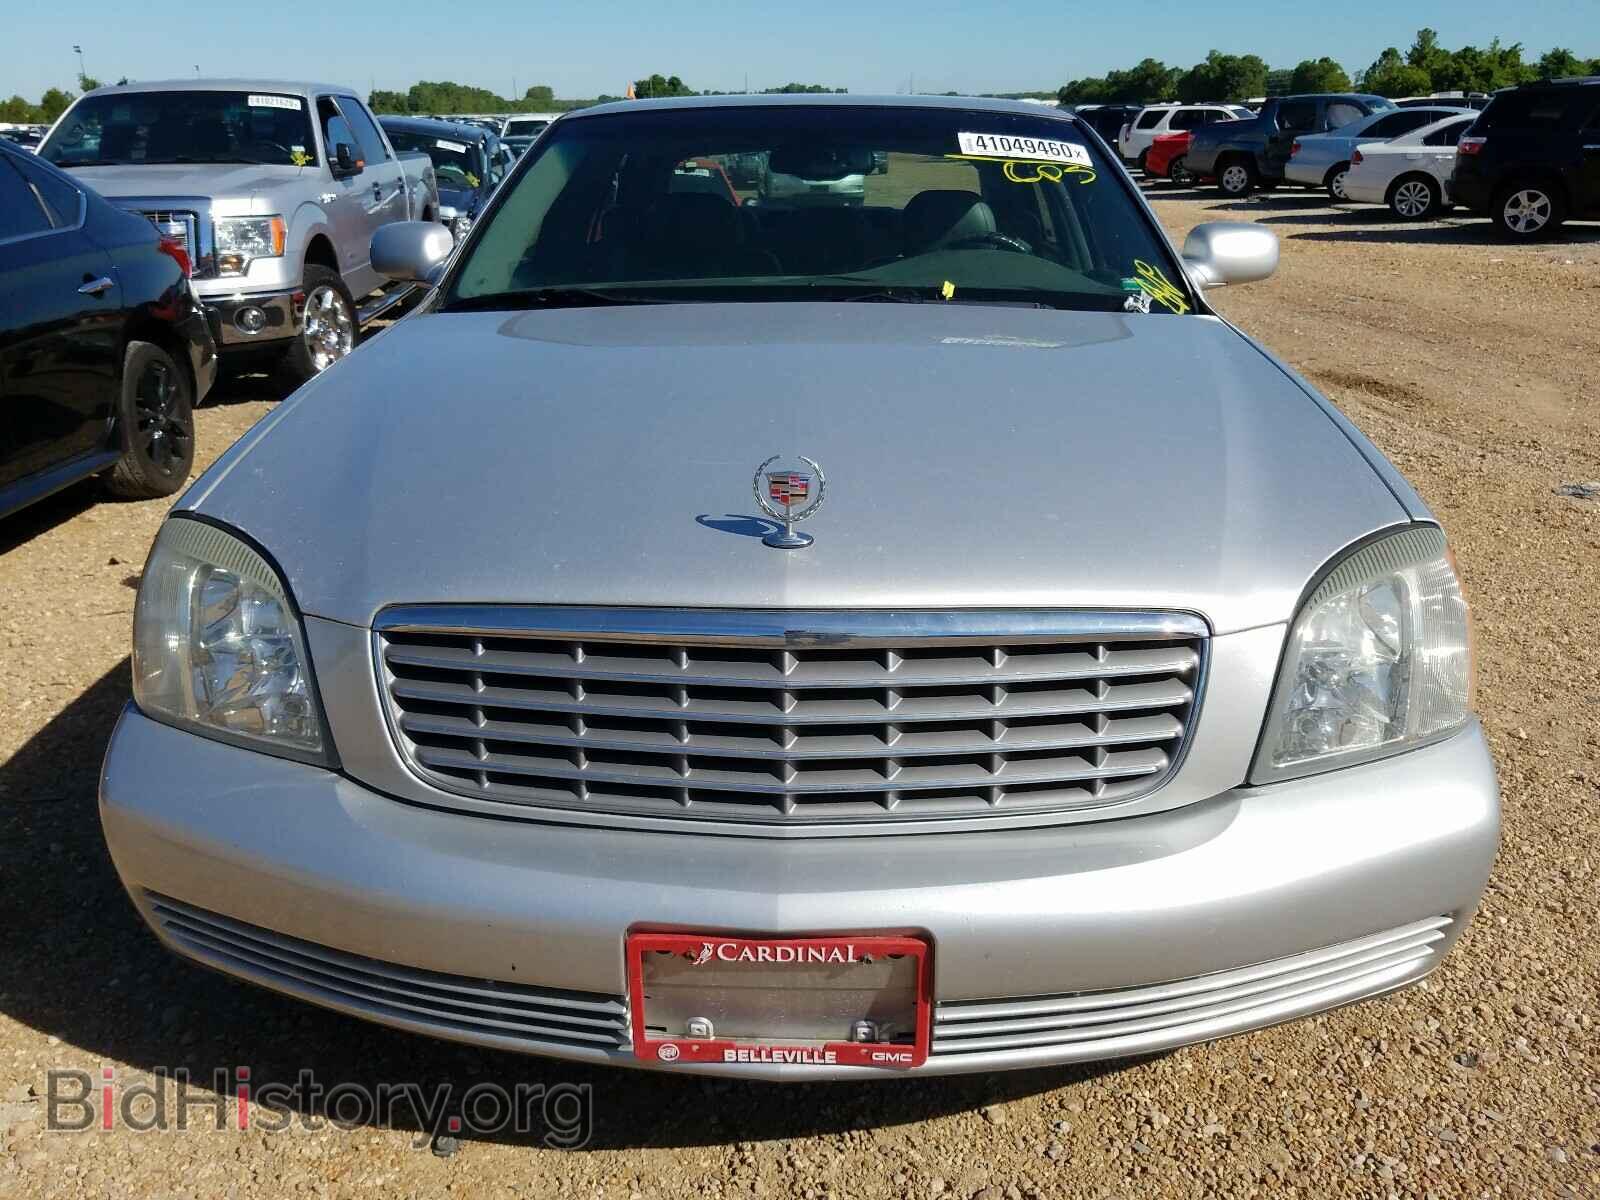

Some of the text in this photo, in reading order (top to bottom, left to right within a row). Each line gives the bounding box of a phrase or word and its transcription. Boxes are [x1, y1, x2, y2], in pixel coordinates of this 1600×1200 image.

[976, 135, 1072, 158] 41049460
[717, 943, 857, 963] CARDINAL
[723, 1049, 836, 1064] BELLEVILLE
[871, 1052, 912, 1062] GMC
